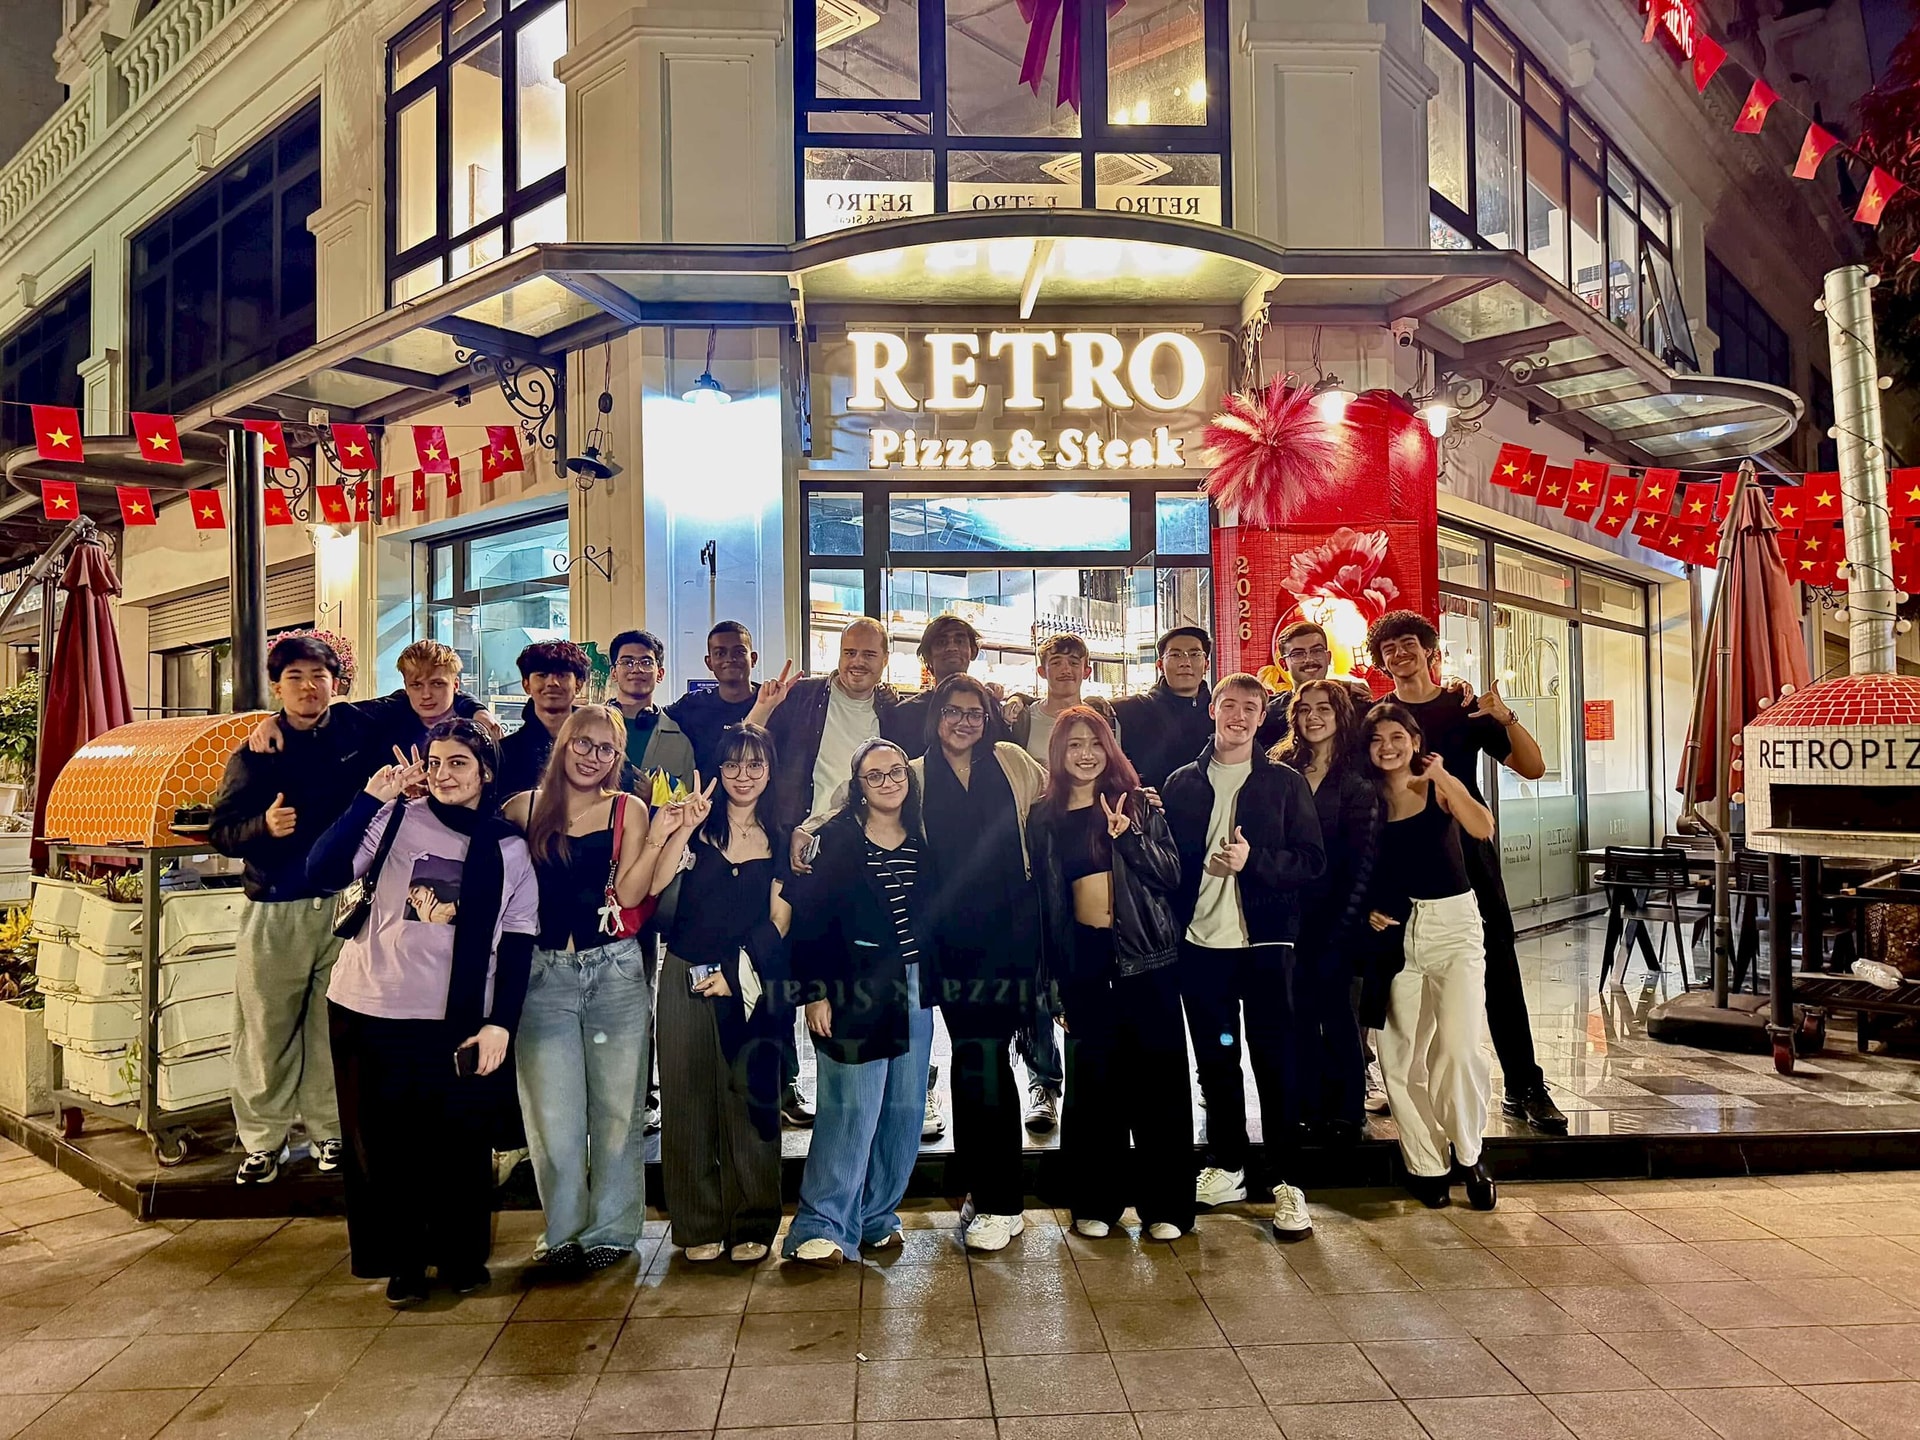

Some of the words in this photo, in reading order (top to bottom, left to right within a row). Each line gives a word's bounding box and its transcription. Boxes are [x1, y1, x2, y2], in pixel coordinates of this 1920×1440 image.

[846, 331, 1206, 410] RETRO
[869, 428, 996, 470] Pizza
[1007, 428, 1047, 470] &
[1055, 425, 1185, 470] Steak
[1235, 555, 1252, 641] 2026
